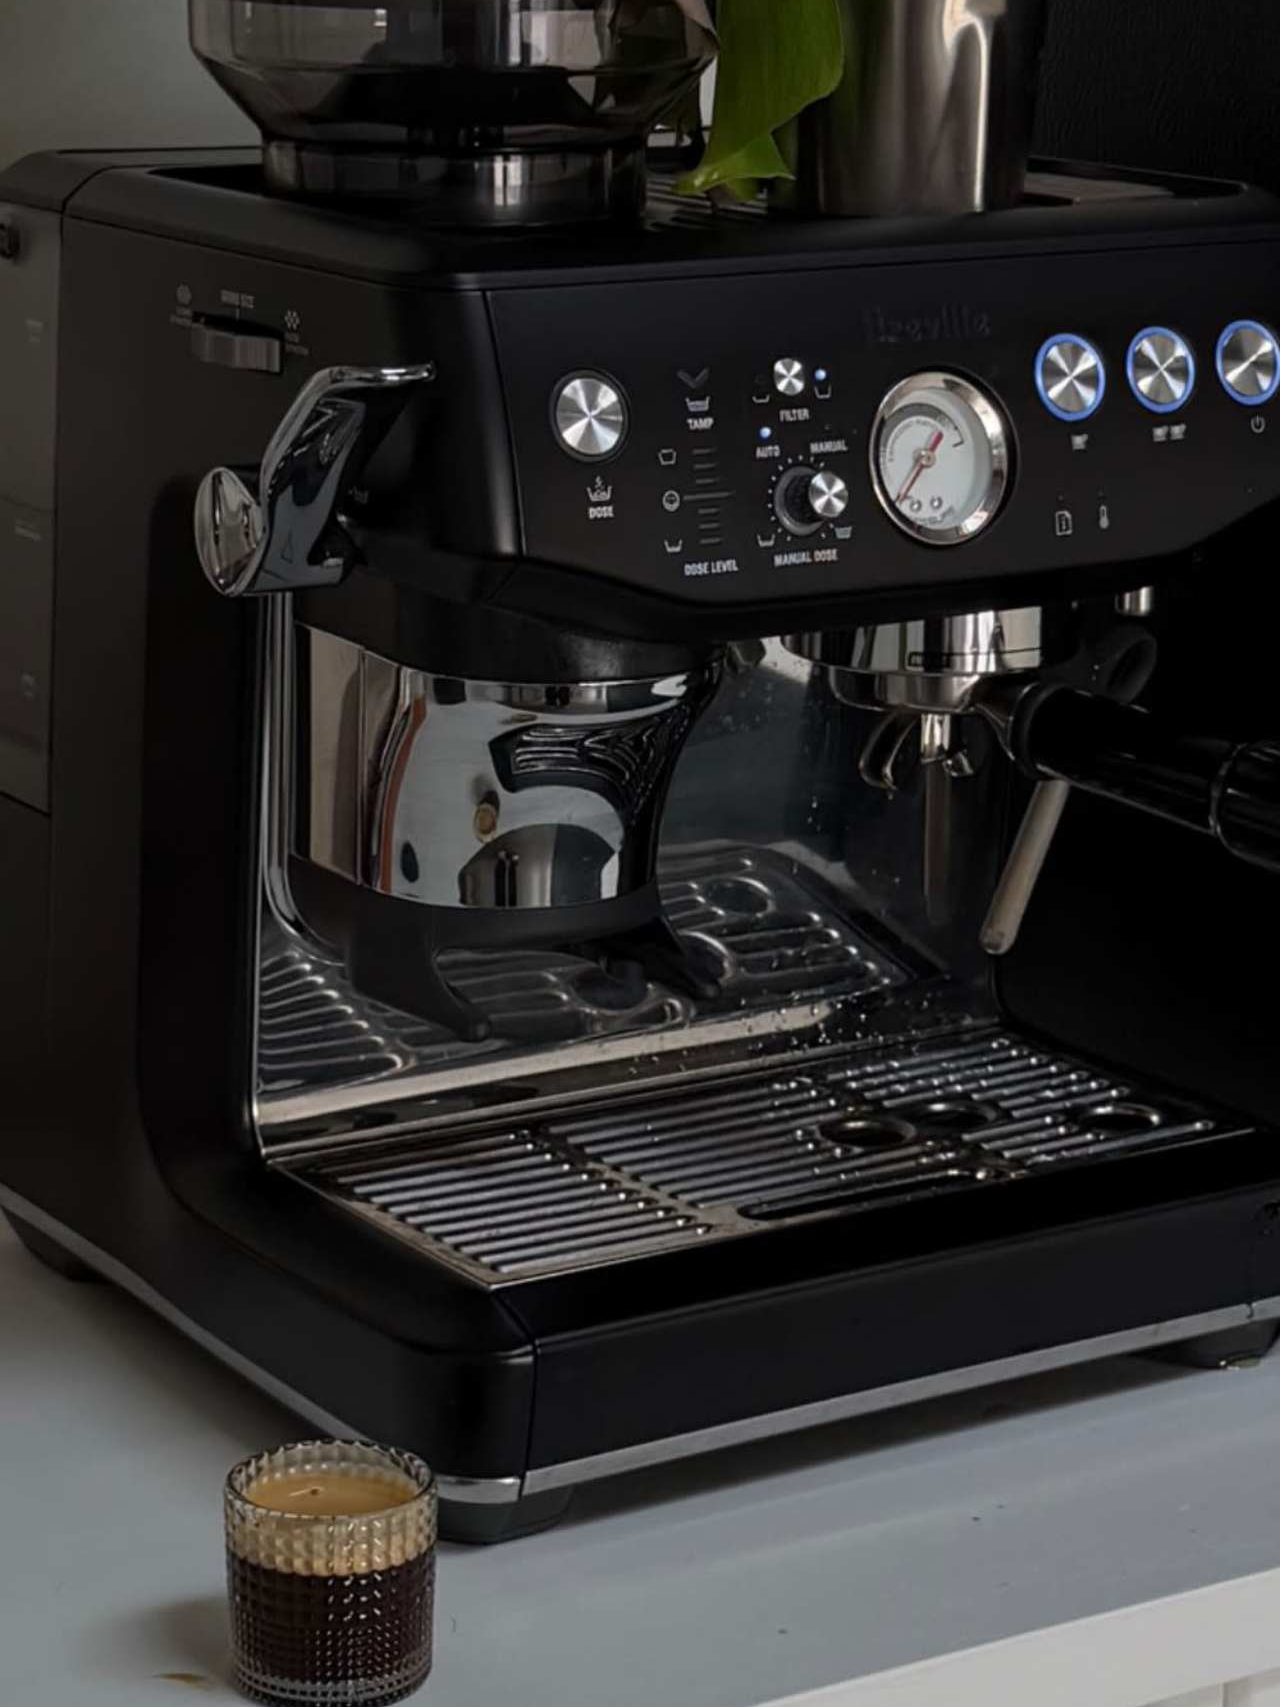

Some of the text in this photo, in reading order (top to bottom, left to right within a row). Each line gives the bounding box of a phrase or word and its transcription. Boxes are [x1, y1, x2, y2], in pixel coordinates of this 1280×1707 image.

[779, 407, 810, 423] FILTER
[687, 416, 715, 431] TAMP
[756, 445, 781, 459] AUTO
[810, 439, 849, 455] MANUAL
[588, 505, 615, 519] DOSE
[773, 547, 839, 567] MANUAL DOSE
[683, 558, 739, 577] DOSE LEVEL
